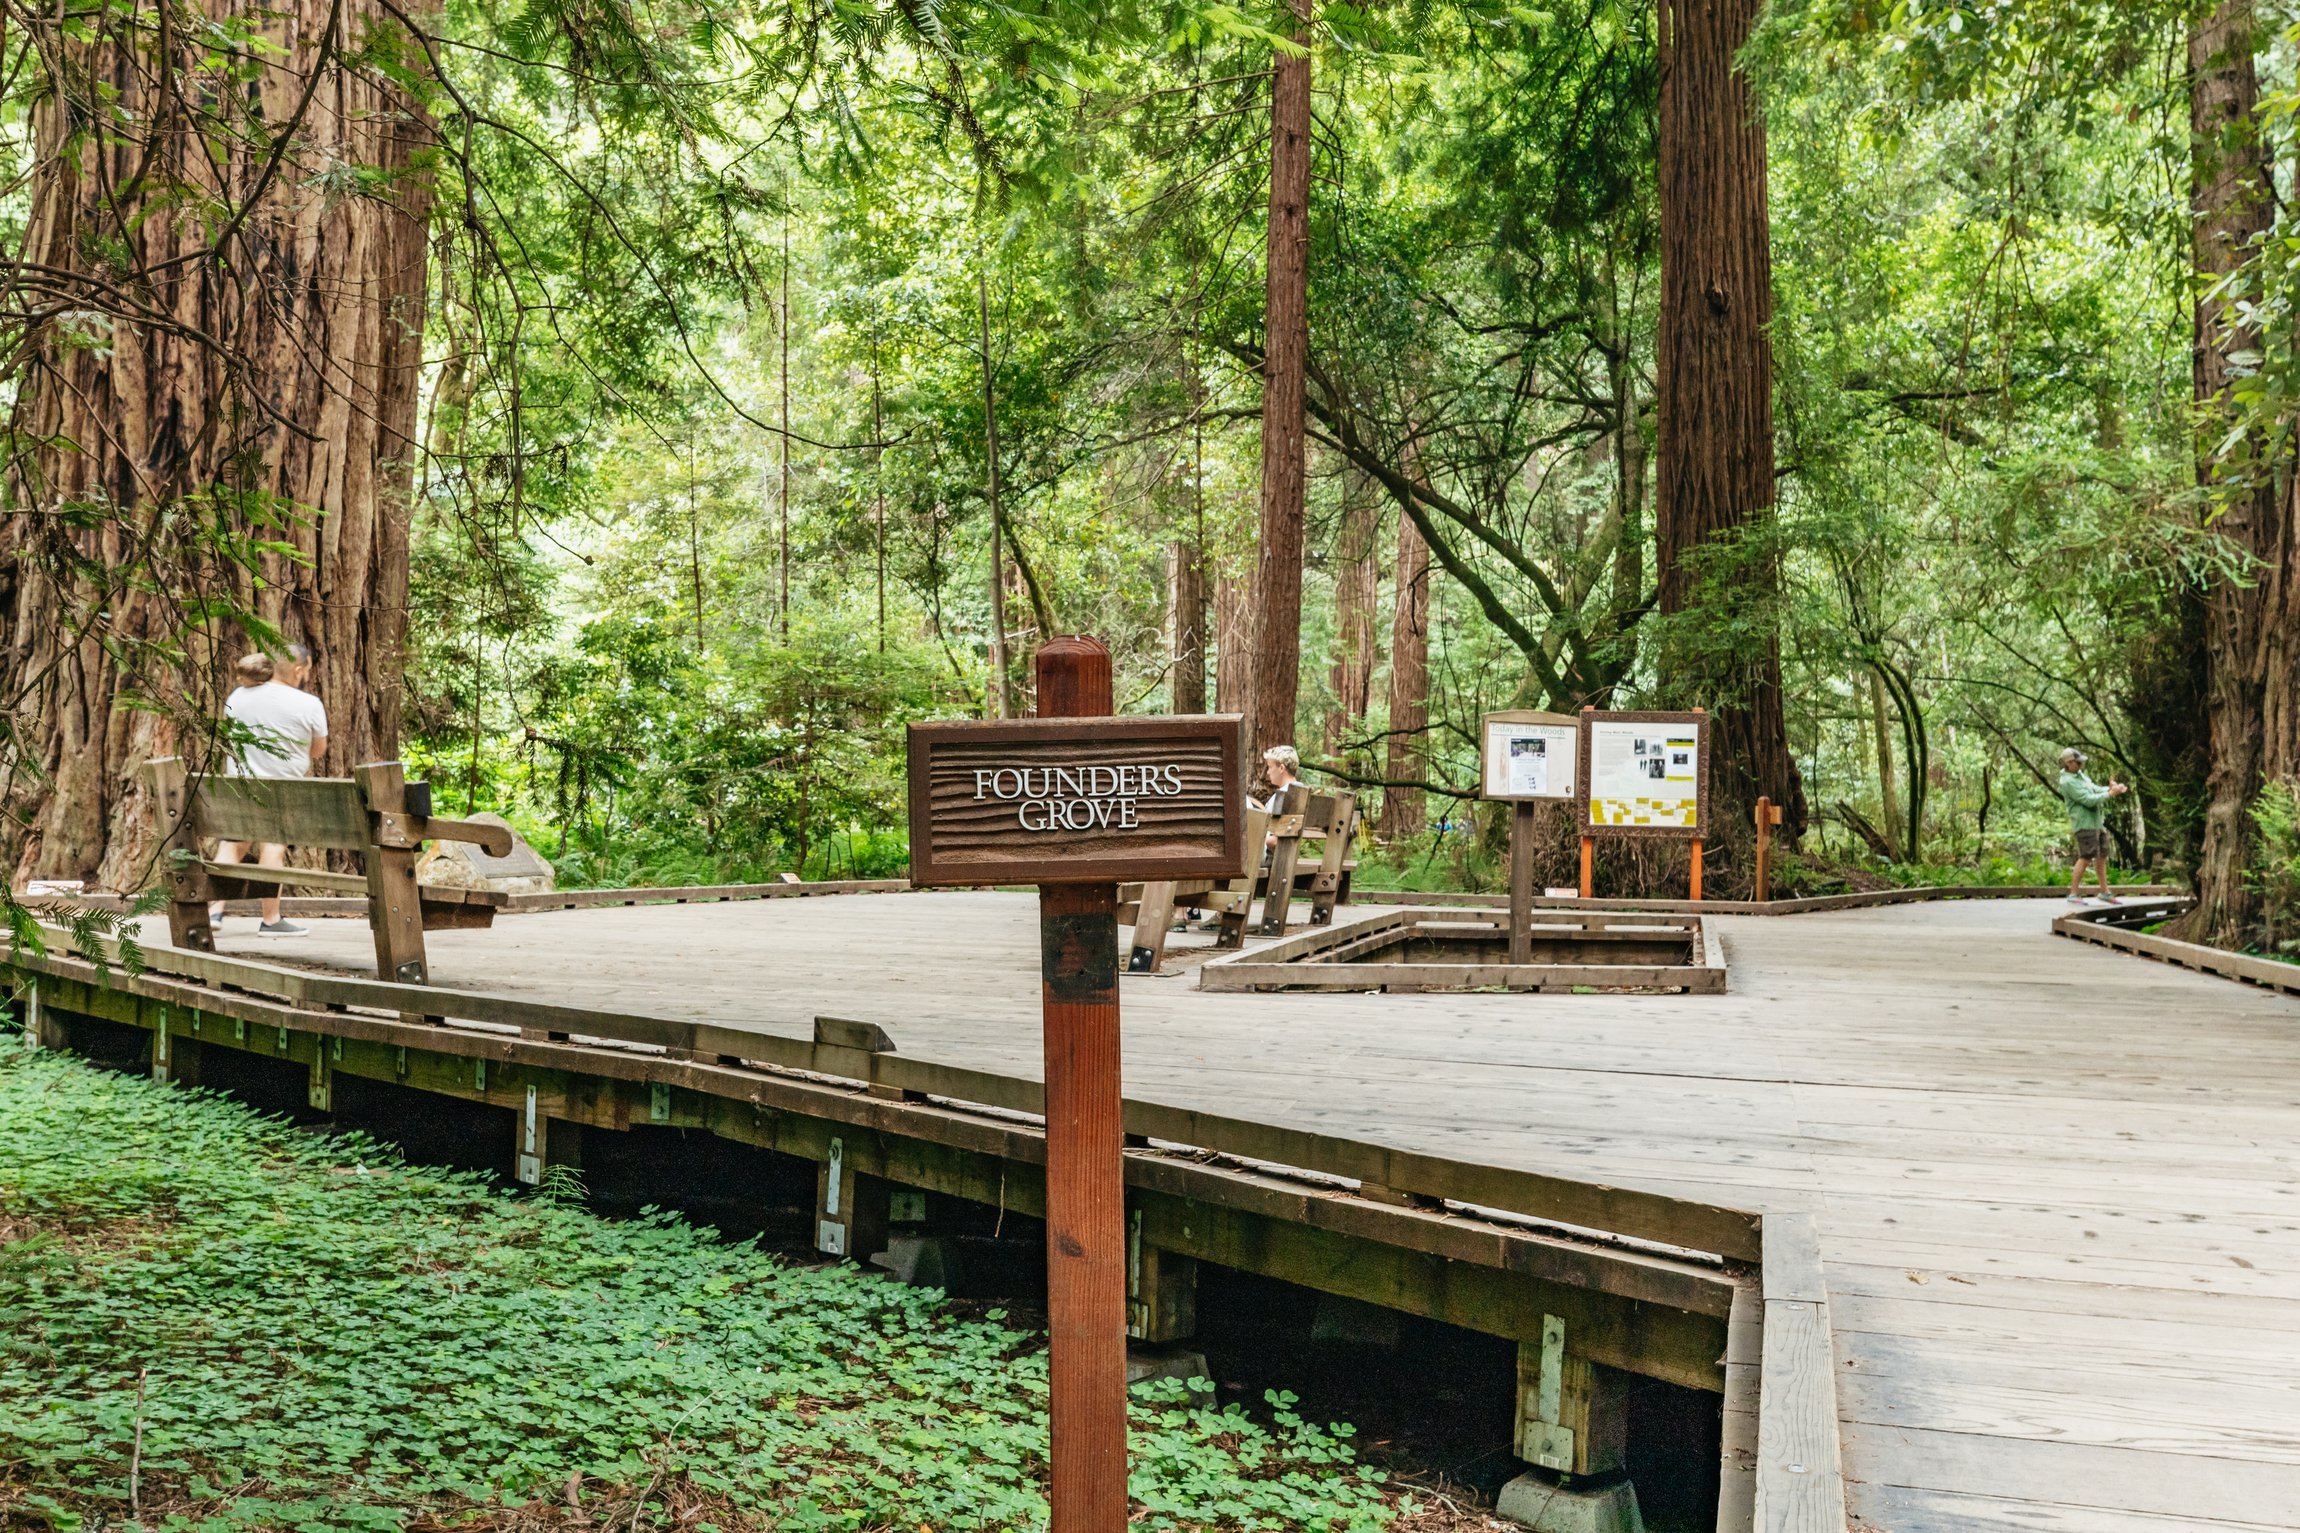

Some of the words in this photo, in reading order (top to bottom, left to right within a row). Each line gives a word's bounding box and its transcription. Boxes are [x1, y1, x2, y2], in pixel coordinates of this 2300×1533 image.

[1491, 723, 1513, 734] Today
[1525, 725, 1537, 734] the
[1539, 727, 1566, 736] Woods
[973, 764, 1182, 800] FOUNDERS
[1018, 798, 1139, 831] GROVE
